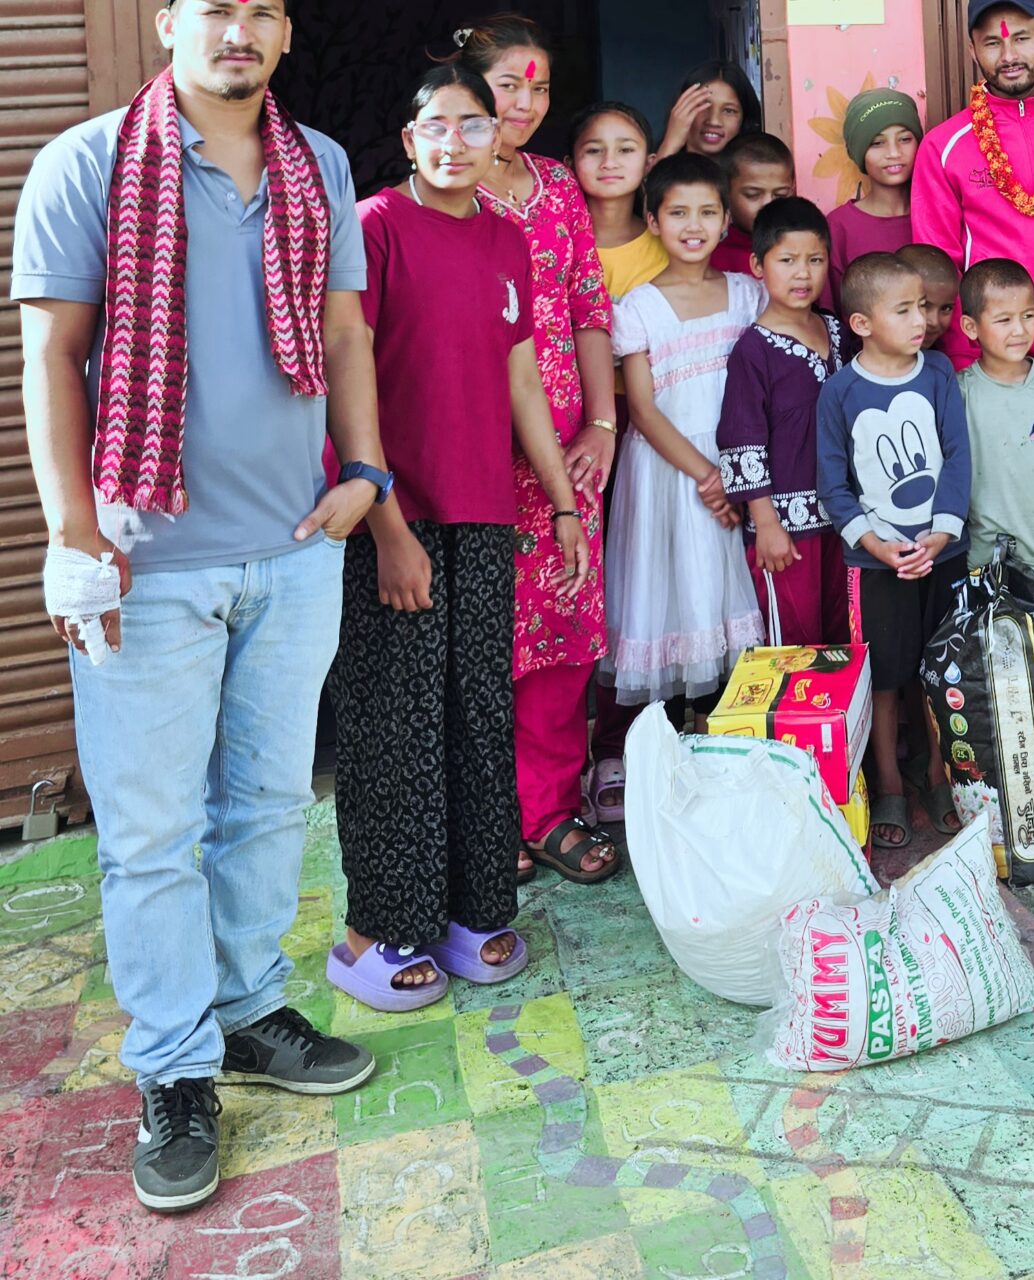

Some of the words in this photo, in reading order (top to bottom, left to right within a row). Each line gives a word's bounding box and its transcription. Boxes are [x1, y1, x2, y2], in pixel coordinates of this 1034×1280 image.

[934, 884, 961, 920] Product
[959, 917, 976, 945] Food
[809, 926, 853, 1064] YUMMY
[868, 939, 892, 1055] PASTA
